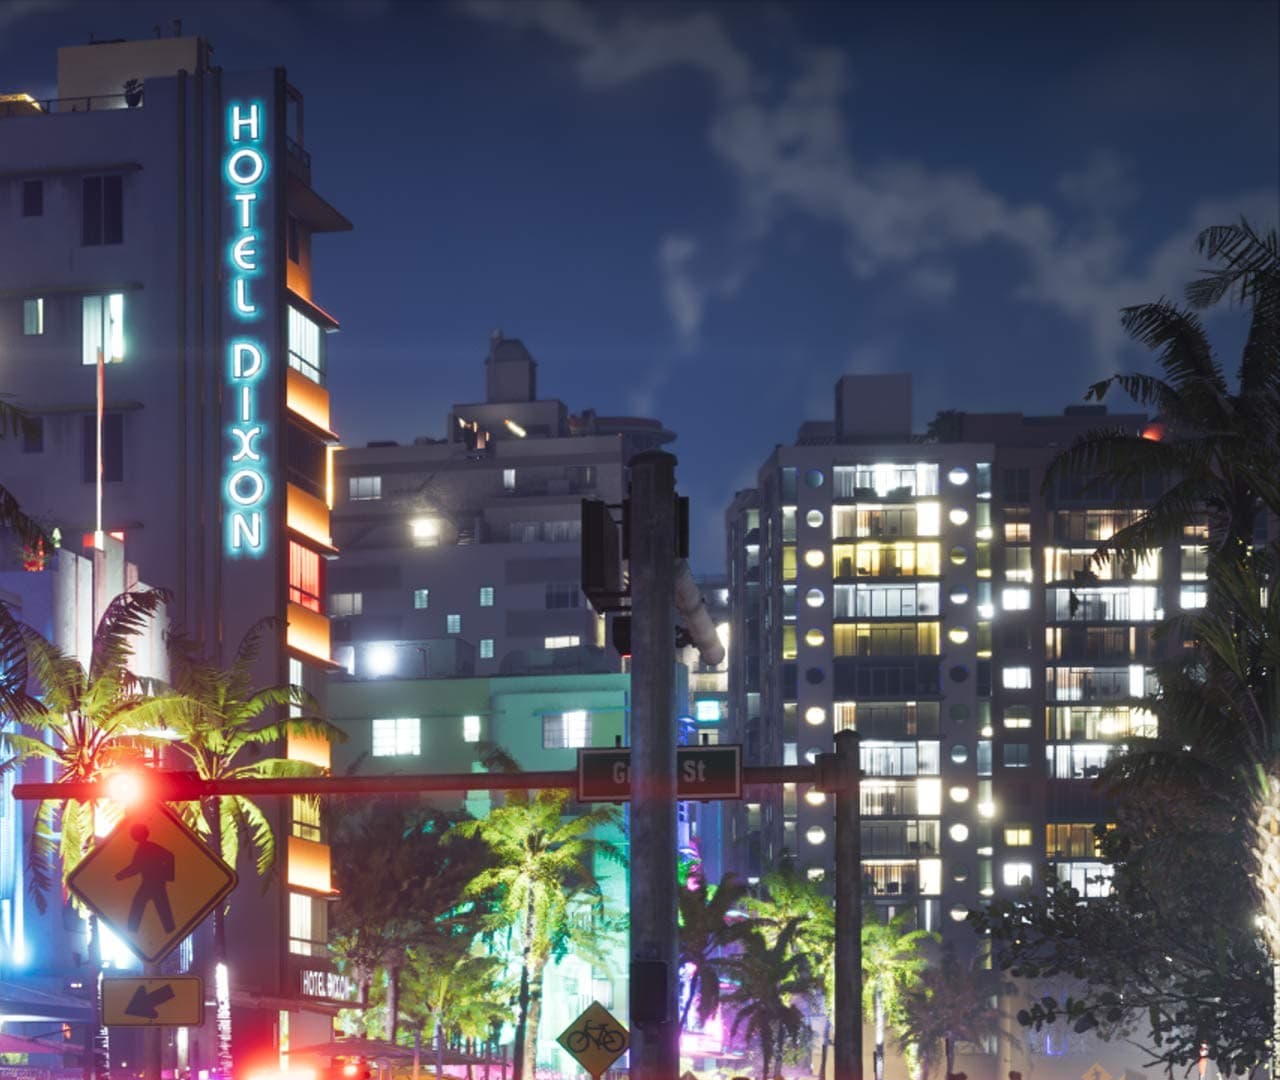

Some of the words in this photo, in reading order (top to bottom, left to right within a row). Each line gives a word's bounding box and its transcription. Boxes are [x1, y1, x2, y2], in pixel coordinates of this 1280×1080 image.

[228, 105, 263, 312] HOTEL
[228, 344, 264, 548] DIXON
[612, 761, 631, 785] G
[683, 759, 705, 783] St
[303, 970, 326, 997] HOTEL
